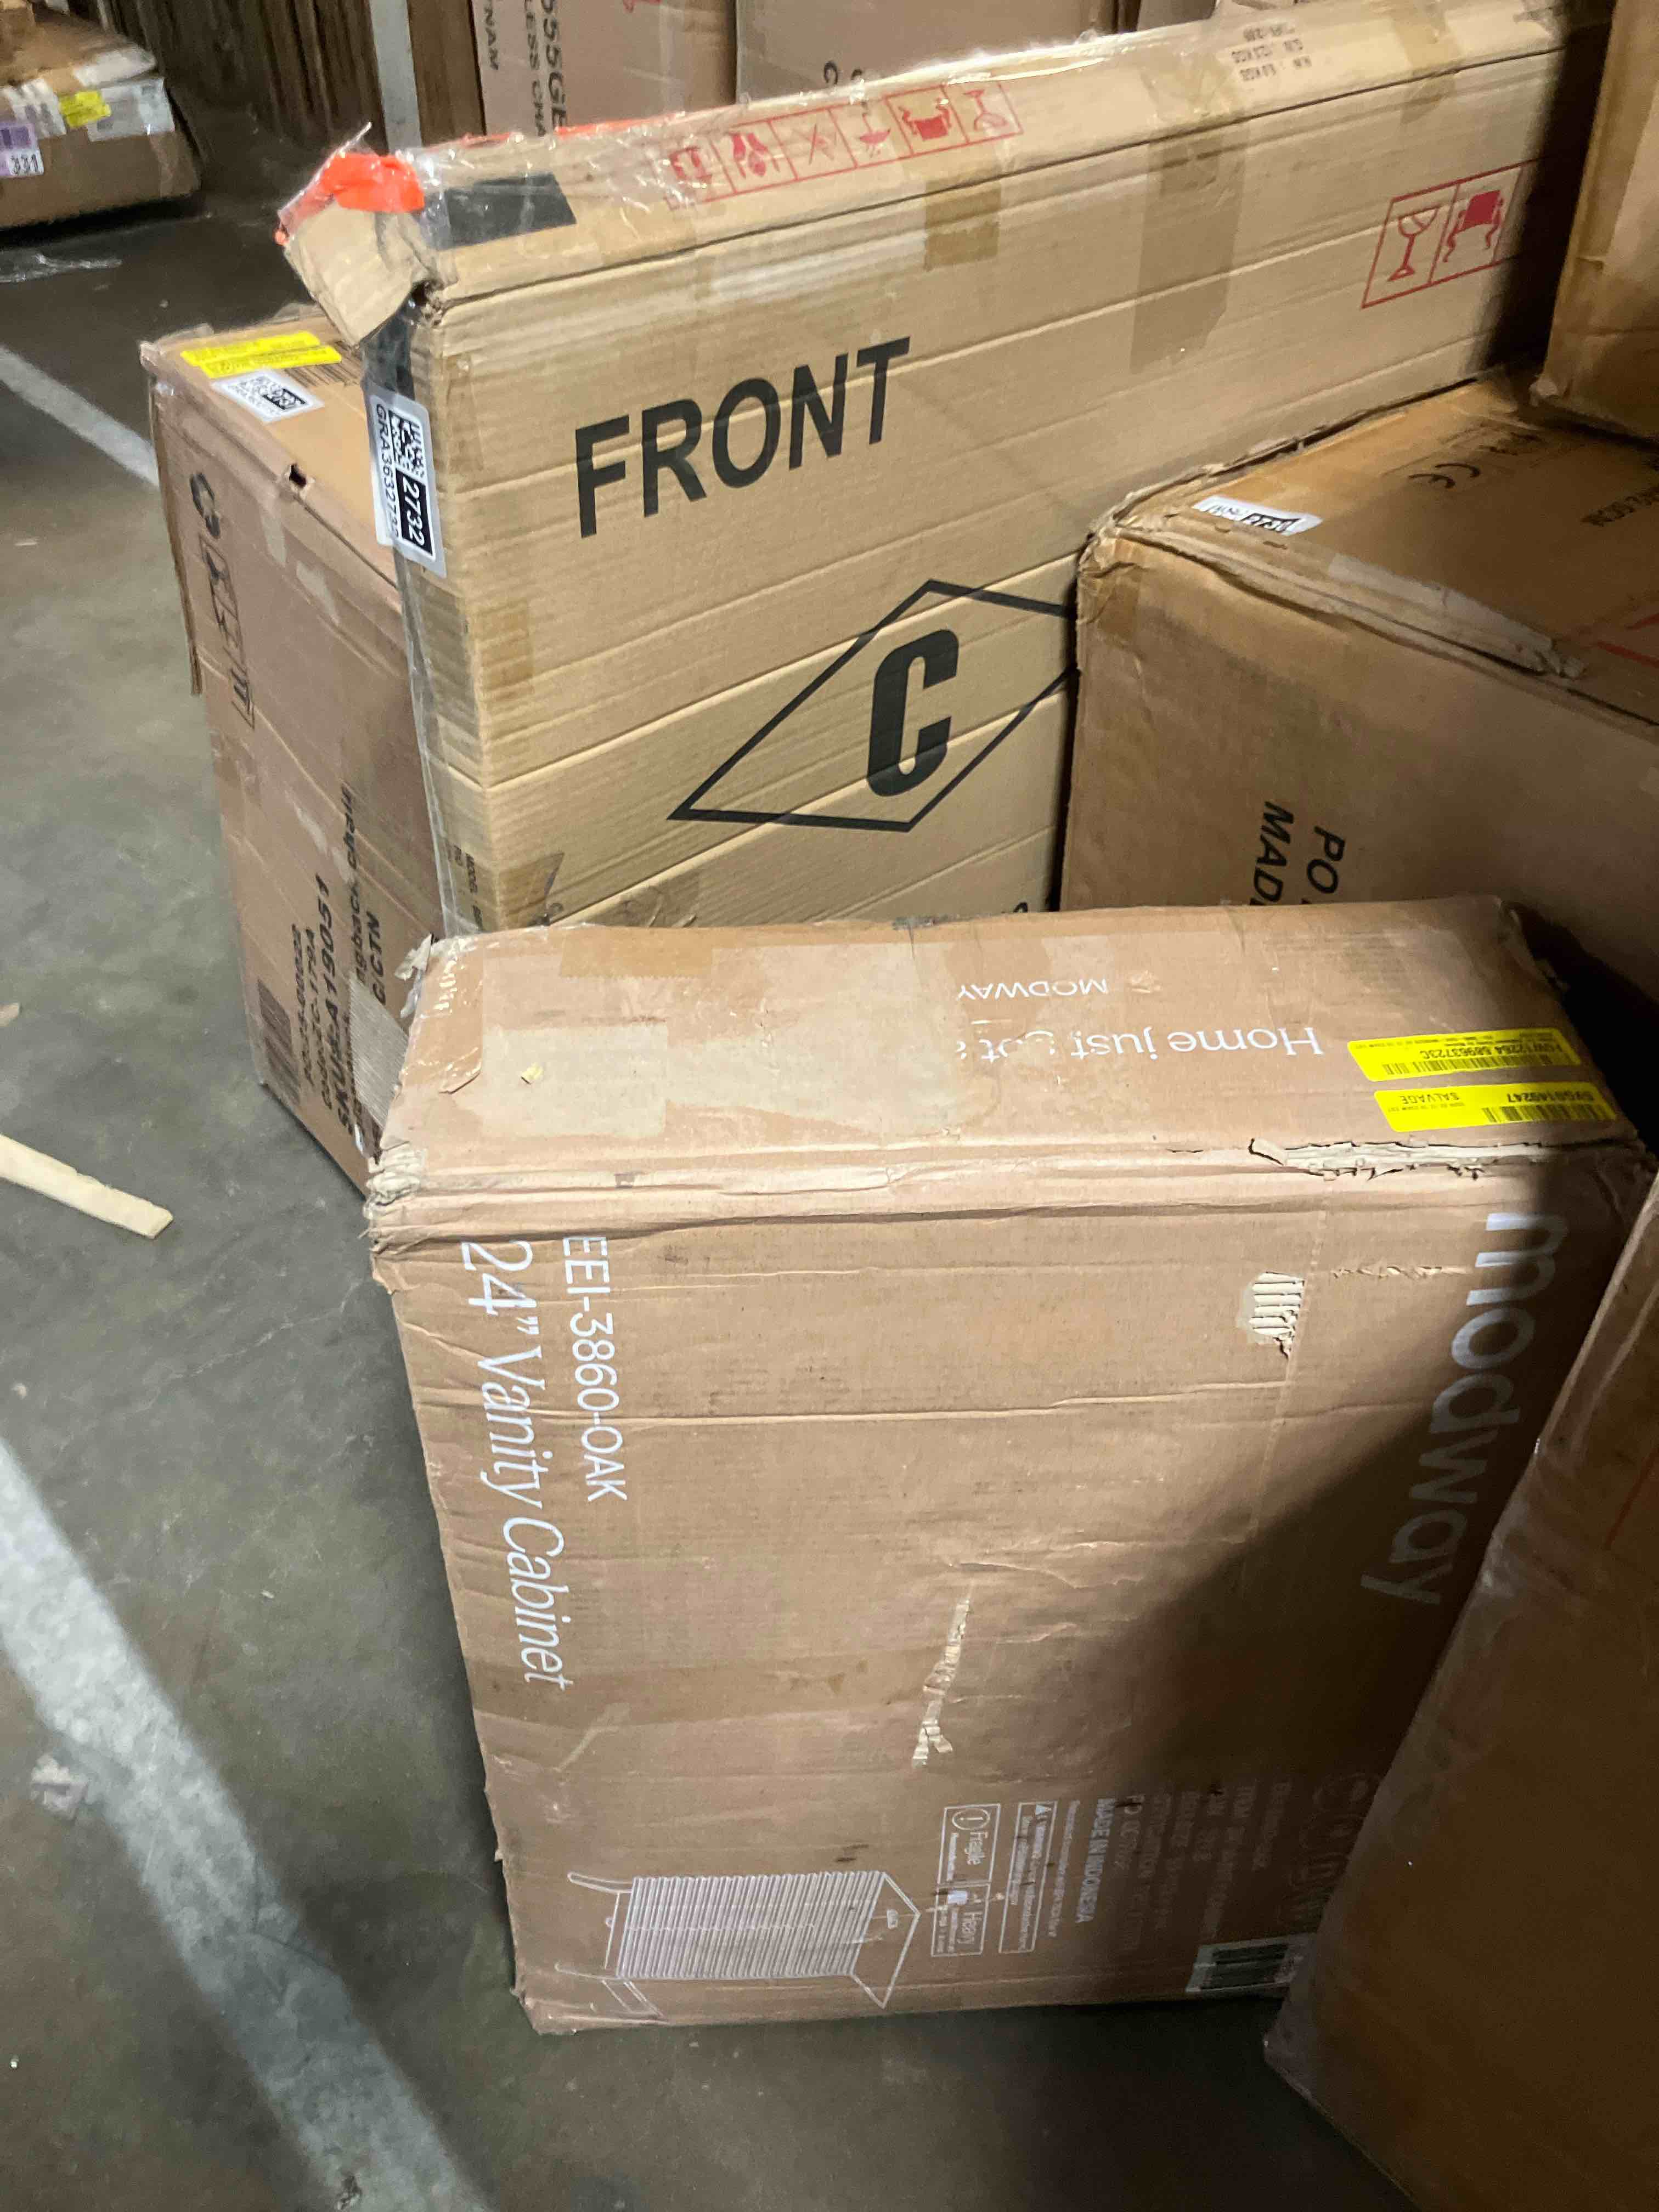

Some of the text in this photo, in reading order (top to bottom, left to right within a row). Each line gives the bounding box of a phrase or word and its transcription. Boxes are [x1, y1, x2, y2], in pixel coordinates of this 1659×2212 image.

[575, 336, 910, 538] FRONT
[402, 476, 425, 546] 2732
[867, 629, 960, 797] C
[956, 978, 1109, 1001] MODWAY
[1071, 1026, 1158, 1060] just
[1167, 1026, 1324, 1056] Home
[1400, 1092, 1460, 1104] SALVAGE
[563, 1236, 628, 1502] EEI-3860-OAK
[1361, 1212, 1568, 1605] modway
[477, 1345, 554, 1510] Vanity
[503, 1517, 574, 1691] Cabinet
[964, 1831, 989, 1865] Fragile
[1075, 1798, 1115, 1923] MADE IN INDONESIA
[956, 1911, 983, 1944] Heavy
